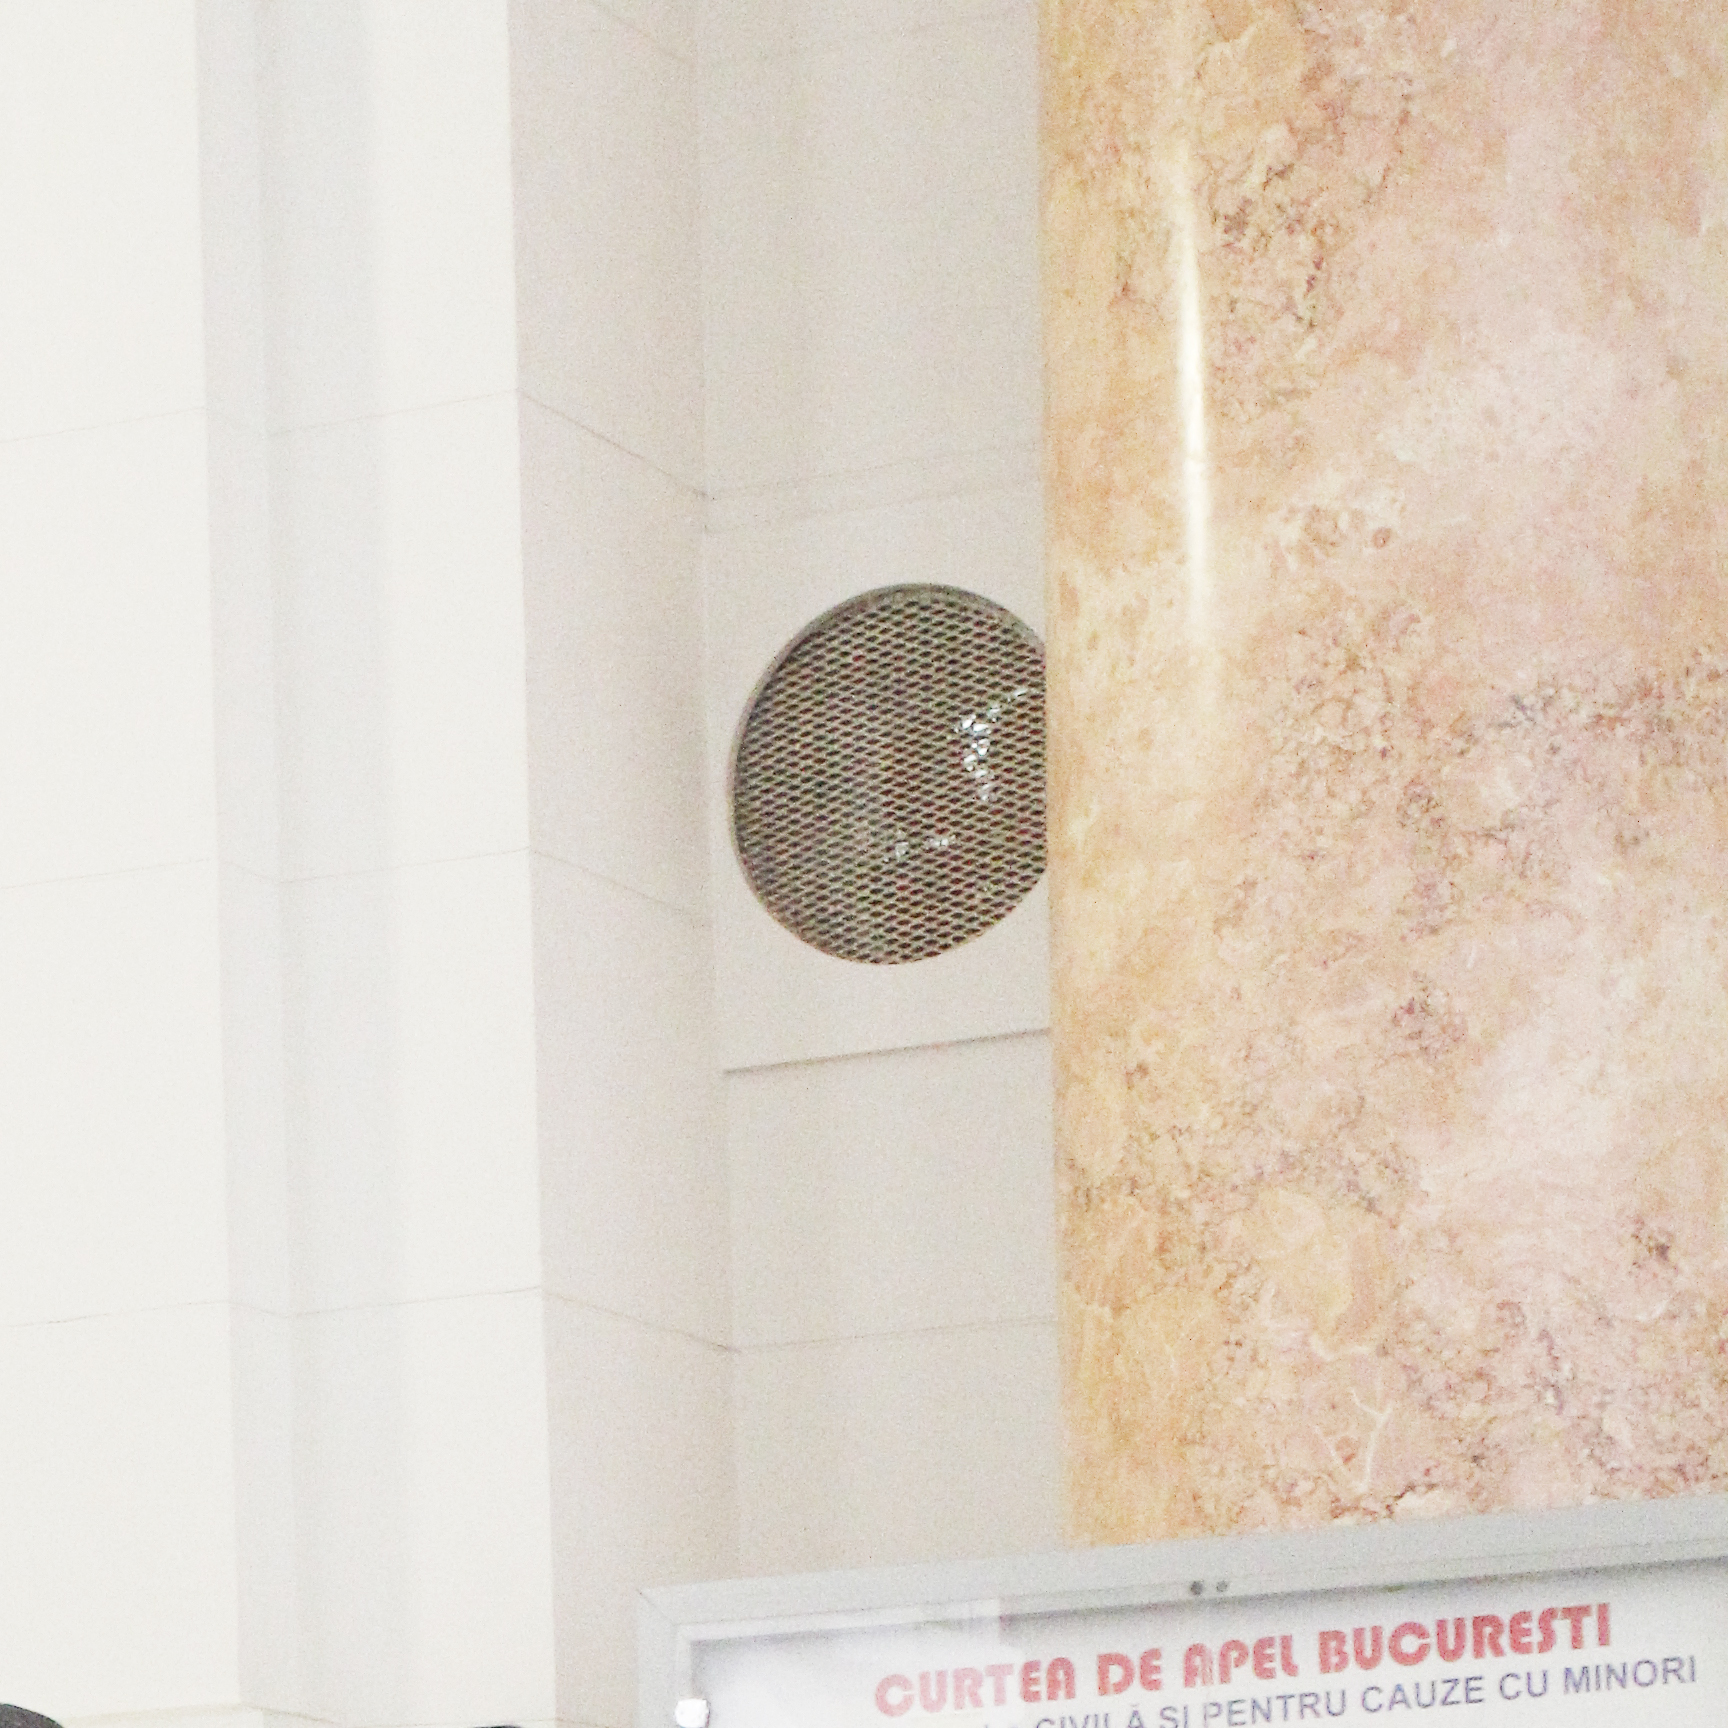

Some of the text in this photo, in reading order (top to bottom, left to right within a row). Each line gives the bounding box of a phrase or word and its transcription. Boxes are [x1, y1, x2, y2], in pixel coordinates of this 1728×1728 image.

[874, 1602, 1611, 1717] CURTEA DE APEL BUCURESTI
[1202, 1688, 1347, 1728] PENTRU
[1361, 1675, 1486, 1714] CAUZE
[1499, 1669, 1549, 1701] CU
[1562, 1655, 1697, 1695] MINORI
